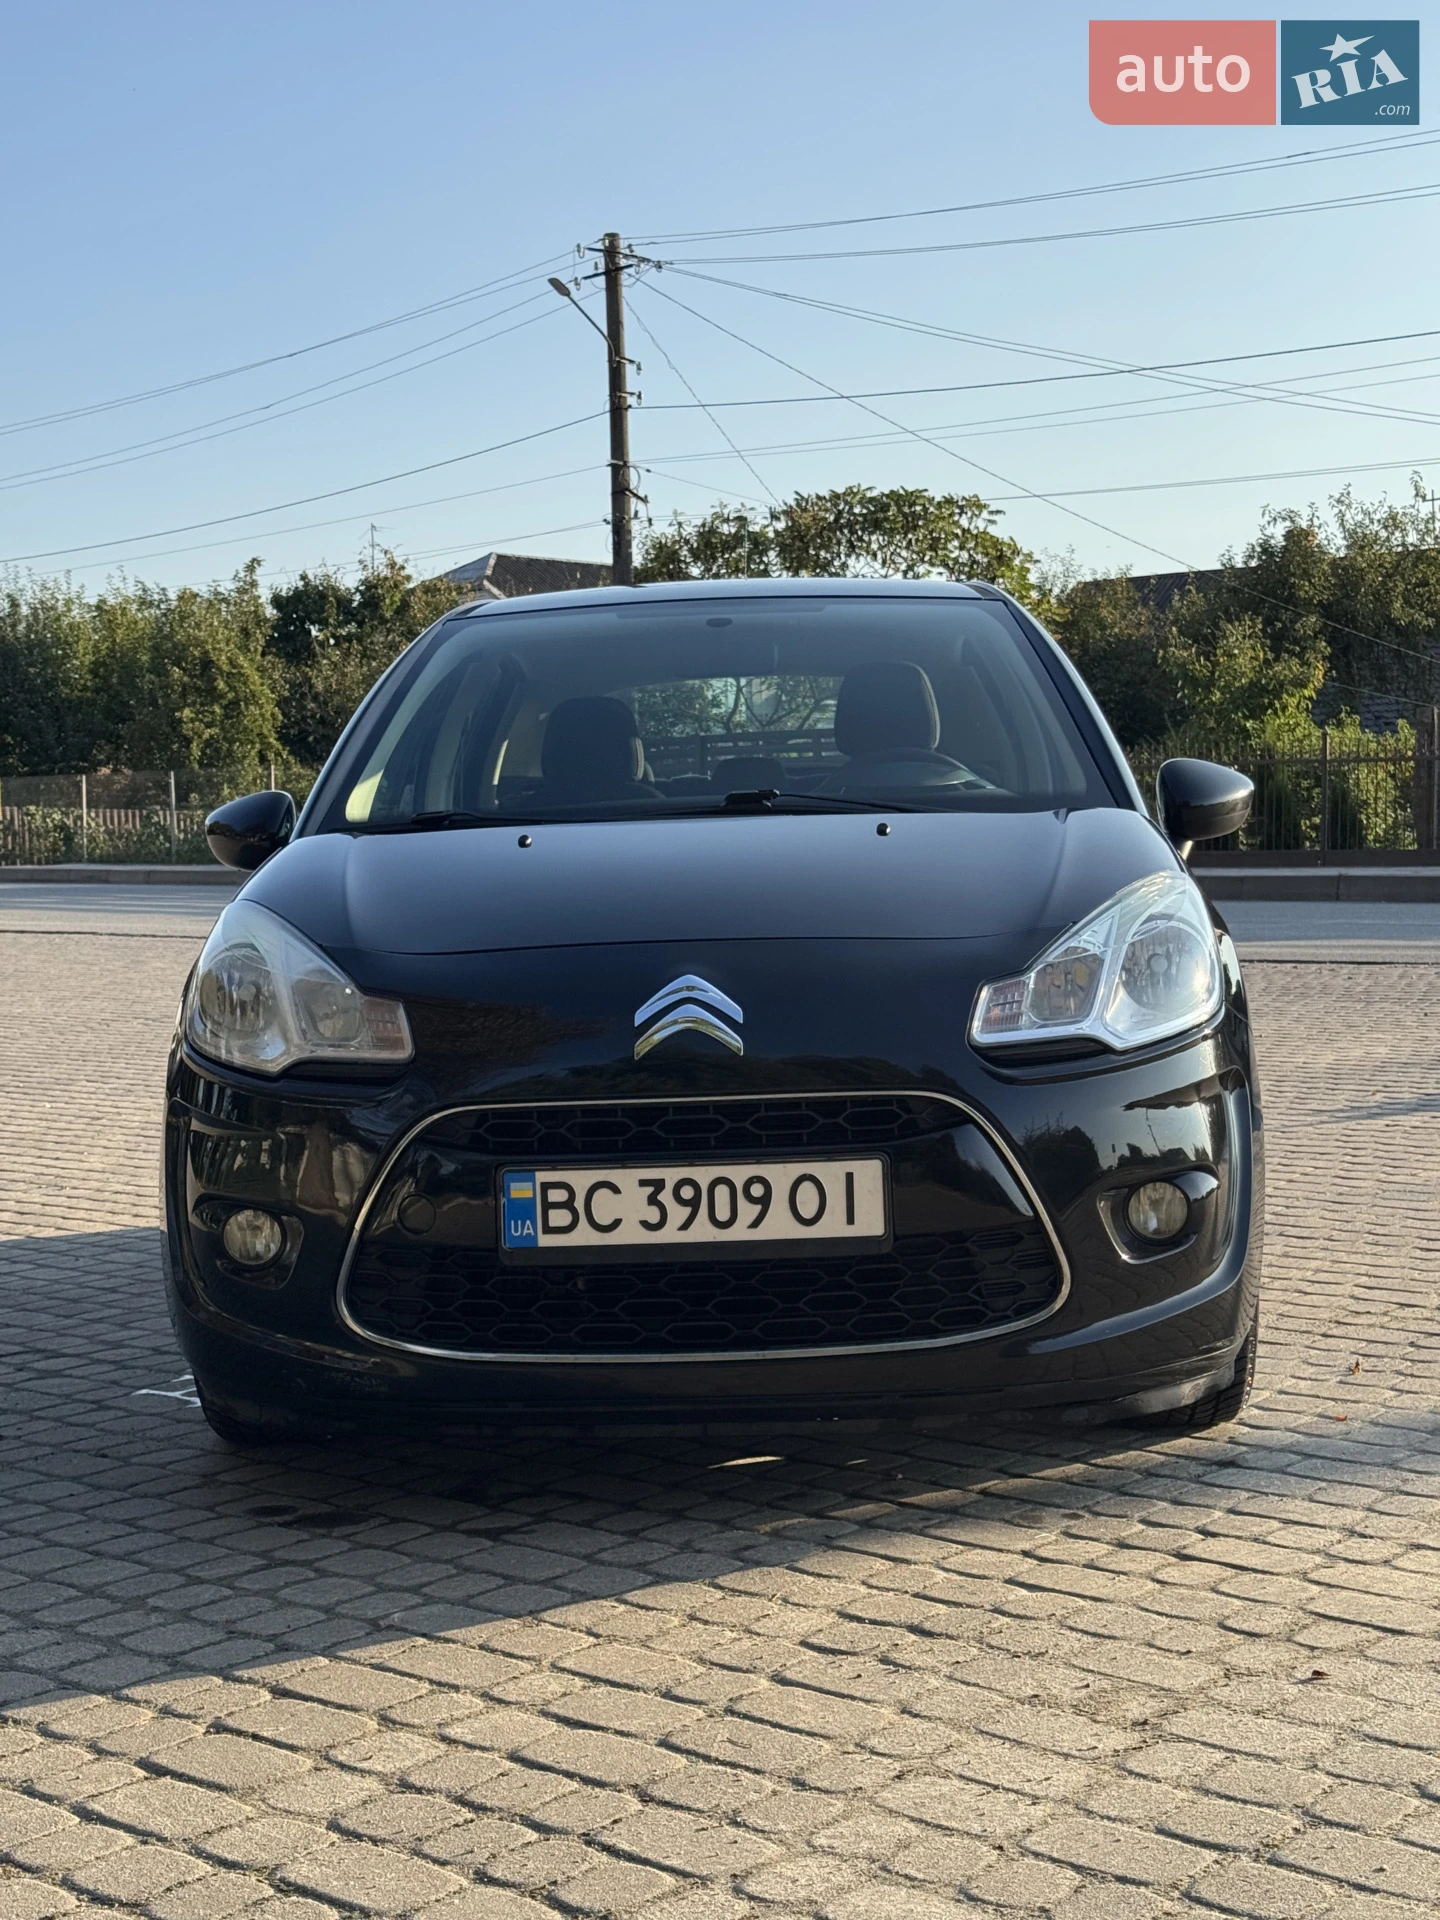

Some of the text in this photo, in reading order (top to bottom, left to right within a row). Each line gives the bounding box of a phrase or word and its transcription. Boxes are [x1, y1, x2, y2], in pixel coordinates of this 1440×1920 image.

[540, 1180, 623, 1234] BC
[638, 1175, 773, 1231] 3909
[511, 1219, 535, 1236] UA
